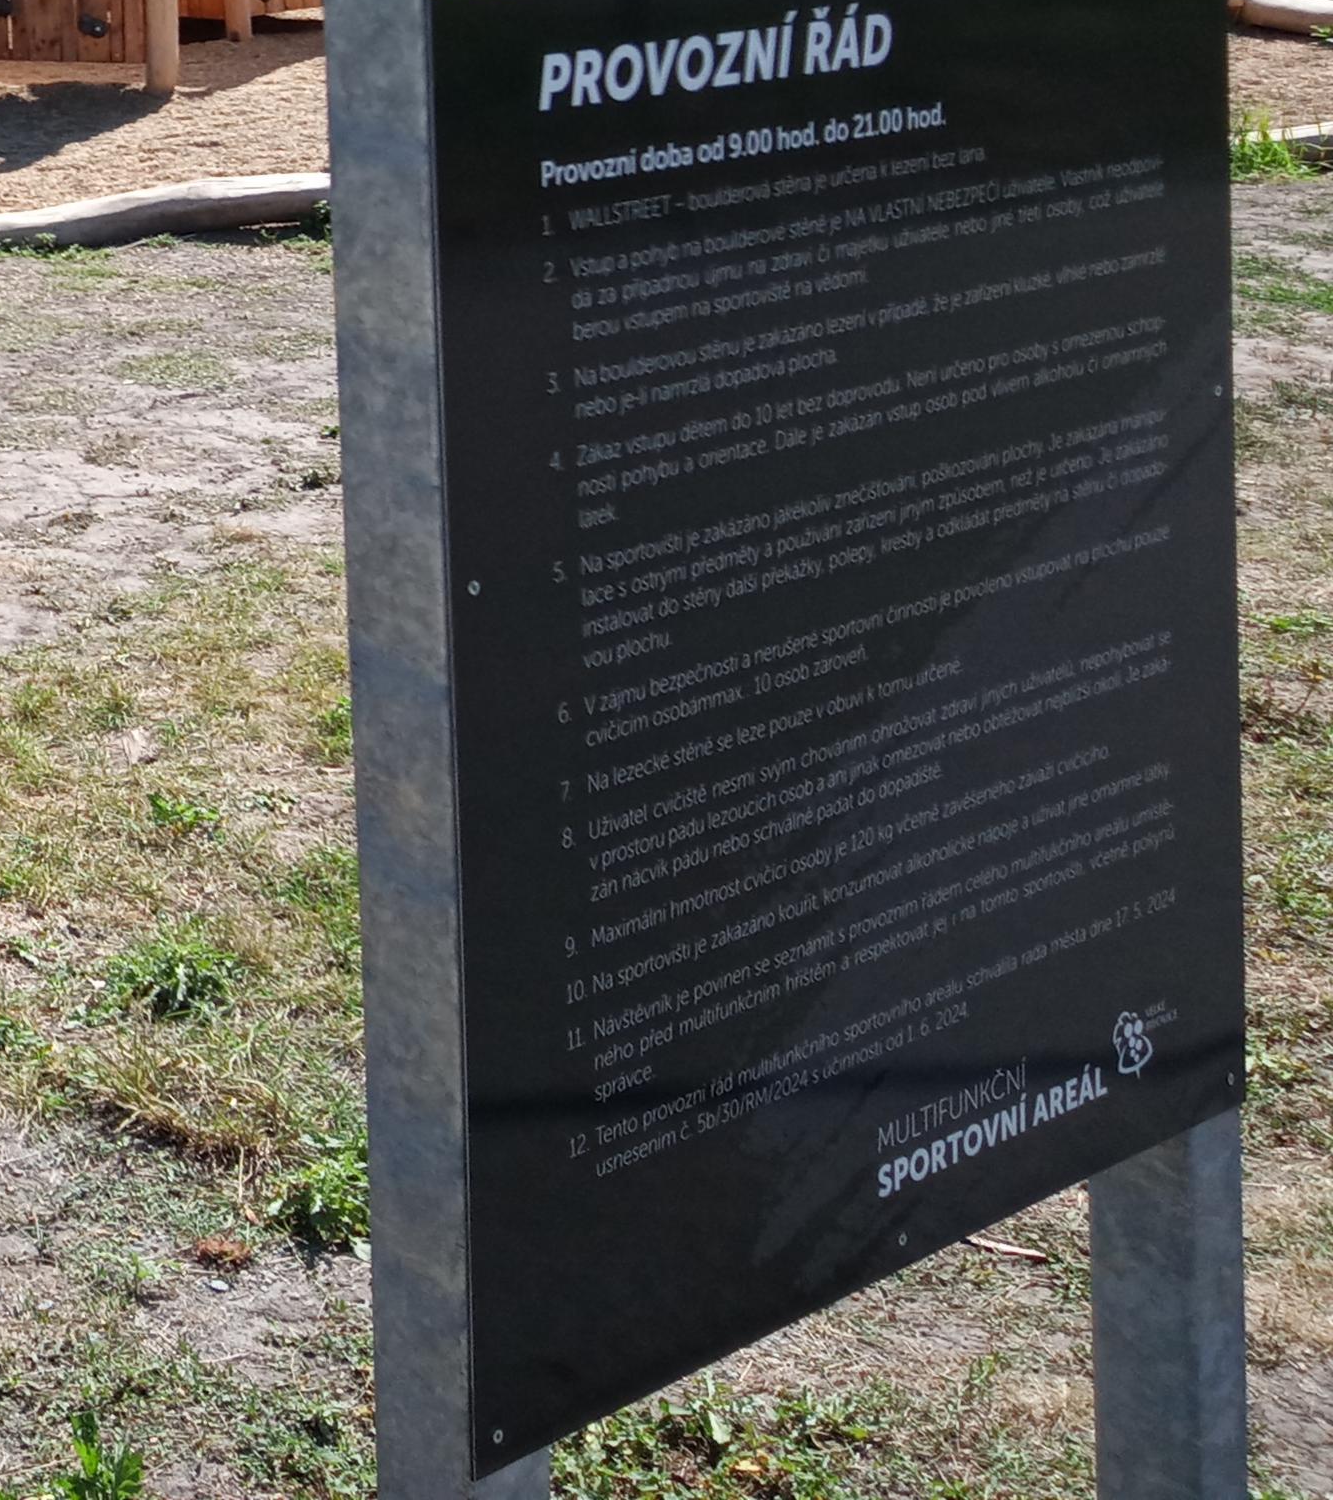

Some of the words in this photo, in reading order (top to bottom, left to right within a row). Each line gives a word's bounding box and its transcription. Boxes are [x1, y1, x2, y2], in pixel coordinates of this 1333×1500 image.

[539, 8, 795, 113] PROVOZNÍ
[804, 2, 893, 78] ŘÁD
[639, 142, 692, 172] doba
[696, 135, 724, 163] od
[728, 127, 772, 158] 9.00
[775, 121, 819, 150] hod.
[823, 118, 849, 143] do
[852, 108, 902, 138] 21.00
[906, 102, 946, 130] hod.
[850, 828, 873, 853] 120
[877, 1054, 1027, 1154] MULTIFUNKČNÍ
[877, 1091, 1027, 1199] SPORTOVNÍ
[1032, 1062, 1107, 1128] AREÁL
